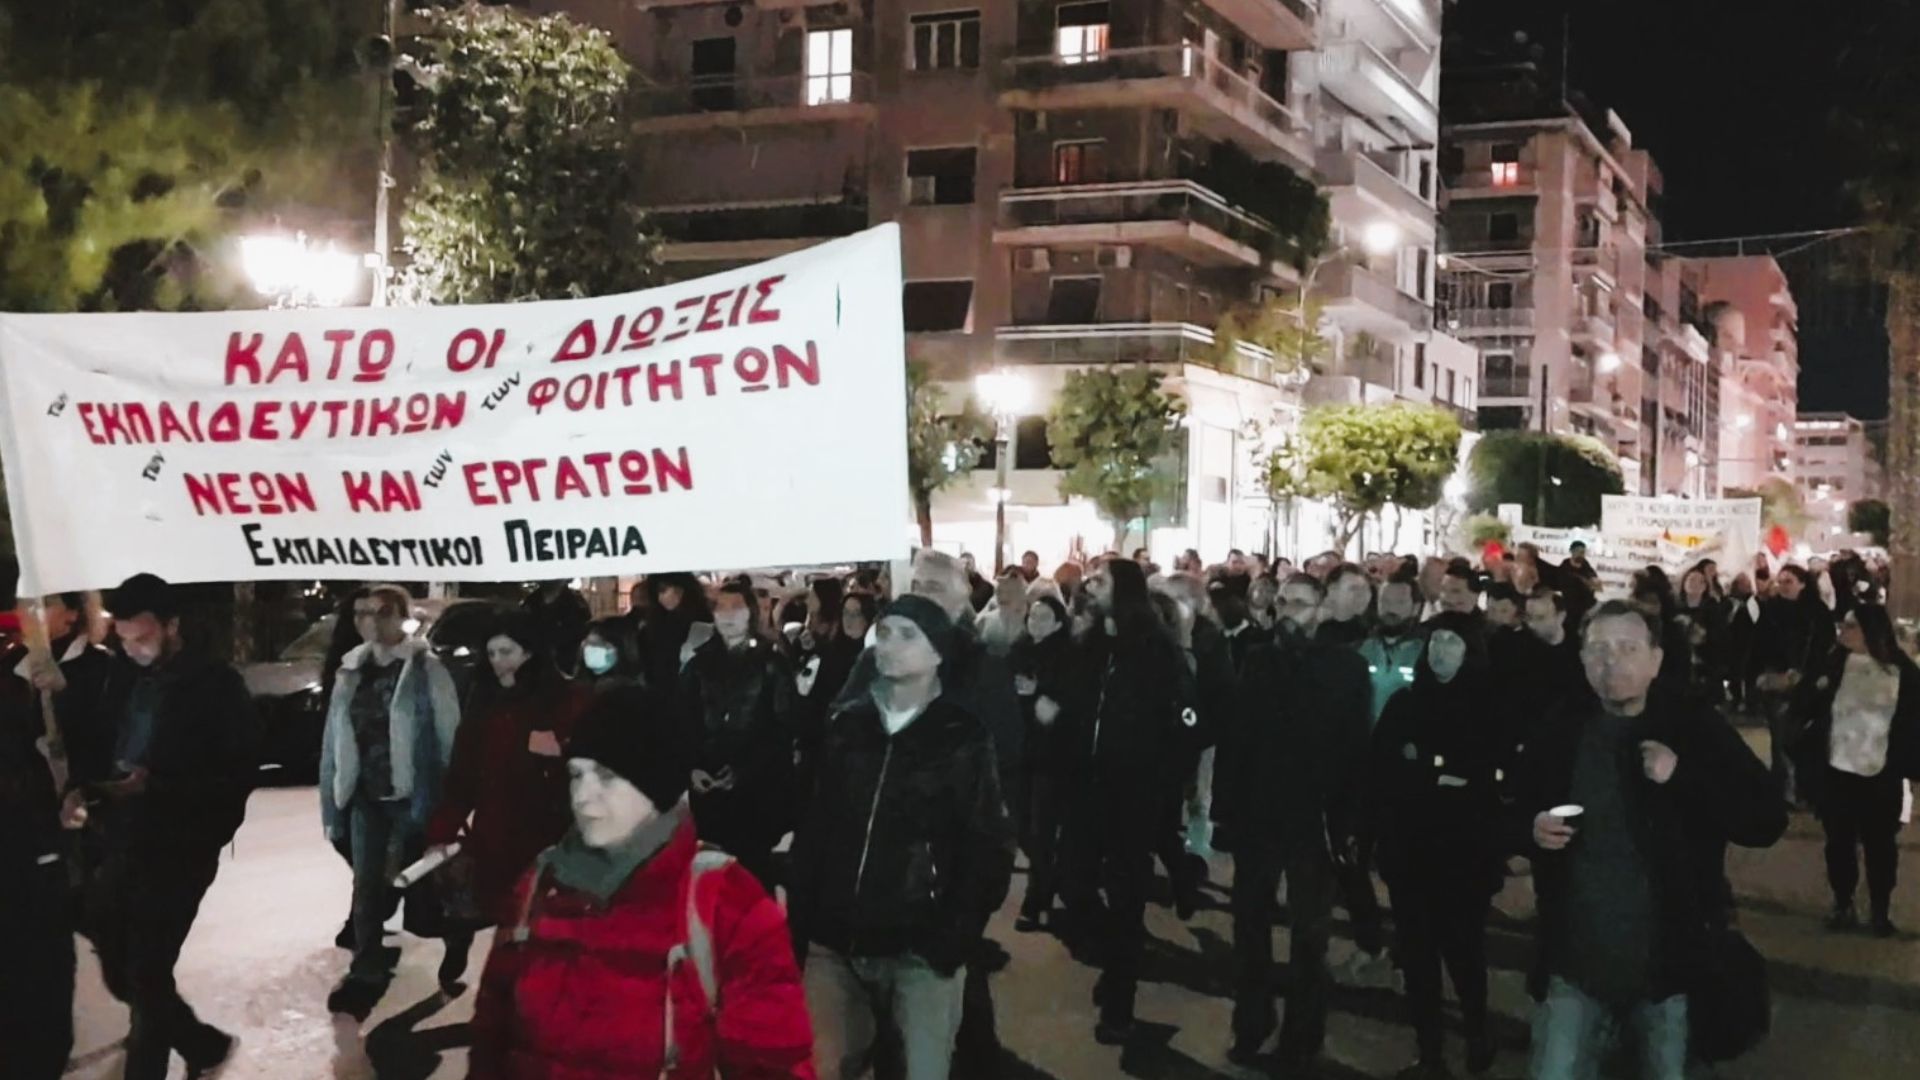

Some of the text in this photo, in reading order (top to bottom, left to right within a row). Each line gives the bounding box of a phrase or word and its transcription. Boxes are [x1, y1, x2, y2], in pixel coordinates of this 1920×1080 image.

[224, 274, 787, 385] ΚΑΤΩ ΟΙ ΔΙΩΞΕΙΣ
[77, 391, 466, 445] ΕΚΠΑΙΔΕΥΤΙΚΩΝ
[481, 371, 521, 411] των
[527, 340, 820, 415] ΦΟΙΤΗΤΩΝ
[183, 472, 317, 516] ΝΕΩΝ
[342, 471, 421, 513] ΚΑΙ
[423, 449, 453, 488] των
[462, 447, 693, 506] ΕΡΓΑΤΩΝ
[241, 519, 647, 567] ΕΚΠΑΙΔΕΥΤΙΚΟΙ ΠΕΙΡΑΙΑ
